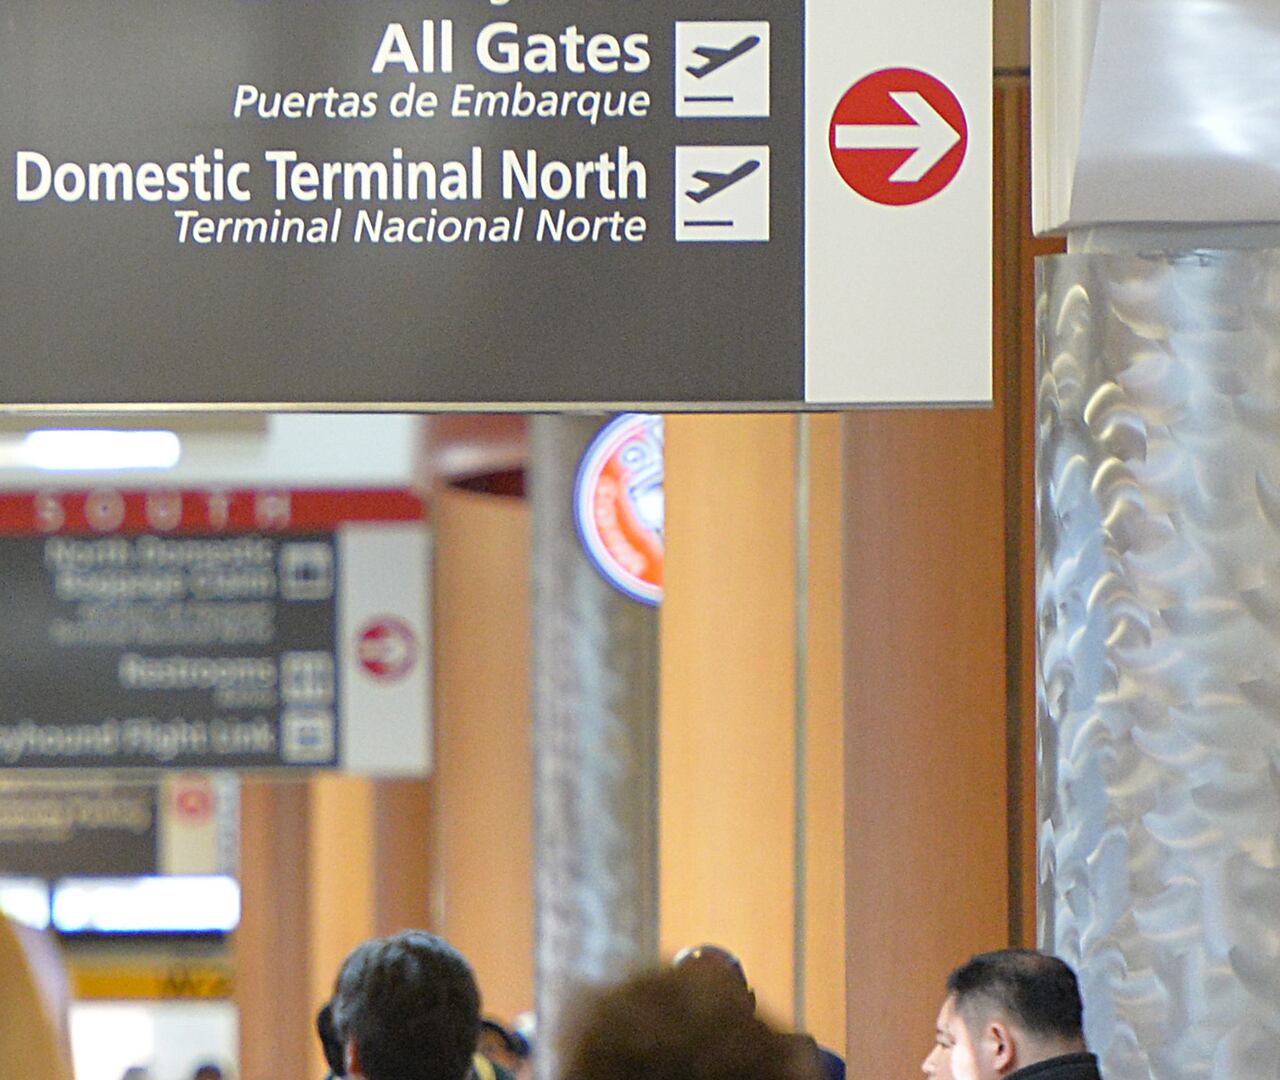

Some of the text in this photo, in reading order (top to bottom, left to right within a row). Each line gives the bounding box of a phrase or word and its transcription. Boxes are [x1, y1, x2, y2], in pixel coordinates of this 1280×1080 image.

[371, 19, 651, 74] All Gates
[233, 81, 650, 124] Puertas de Embarque
[16, 146, 647, 202] Domestic Terminal North
[174, 206, 647, 244] Terminal Nacional Norte
[33, 492, 293, 532] SOUTH
